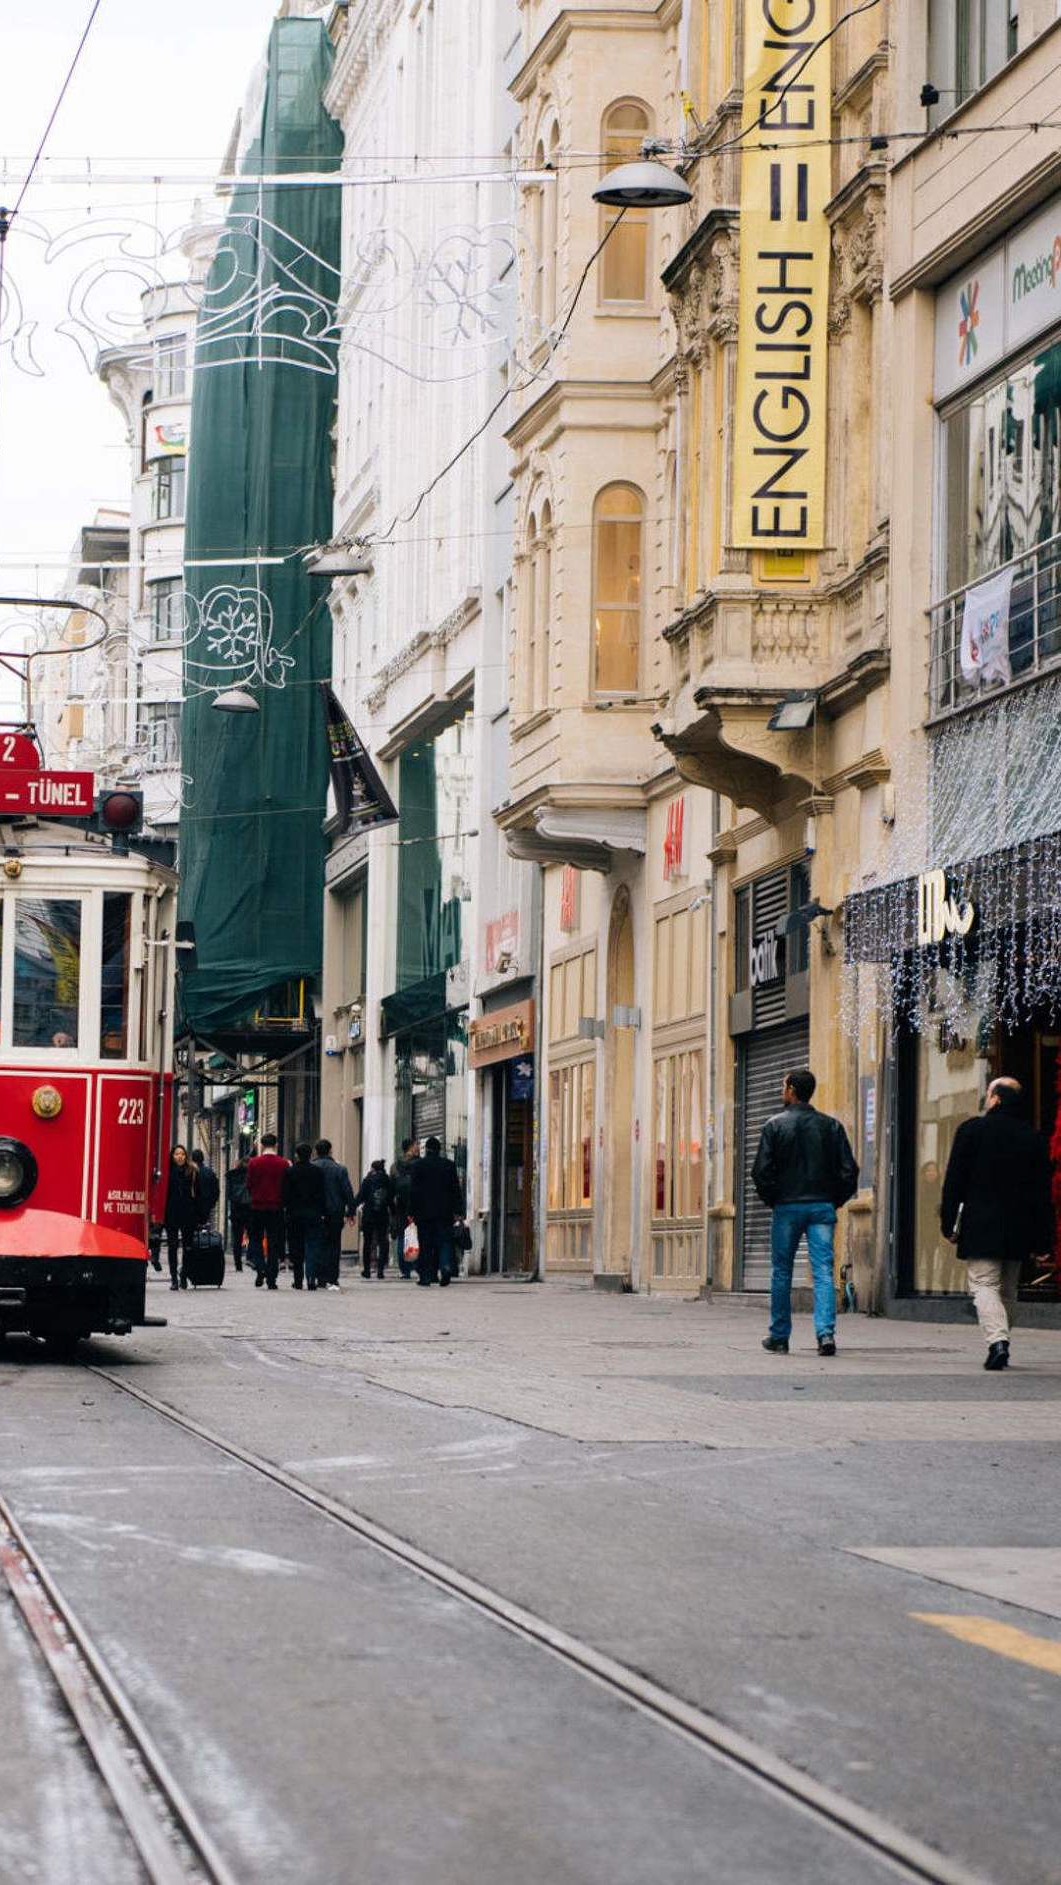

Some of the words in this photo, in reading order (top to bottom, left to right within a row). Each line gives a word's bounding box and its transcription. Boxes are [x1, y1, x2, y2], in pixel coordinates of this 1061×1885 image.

[750, 251, 813, 538] ENGLISH
[1, 735, 17, 763] 2
[27, 778, 87, 806] TÜNEL
[118, 1097, 145, 1125] 223
